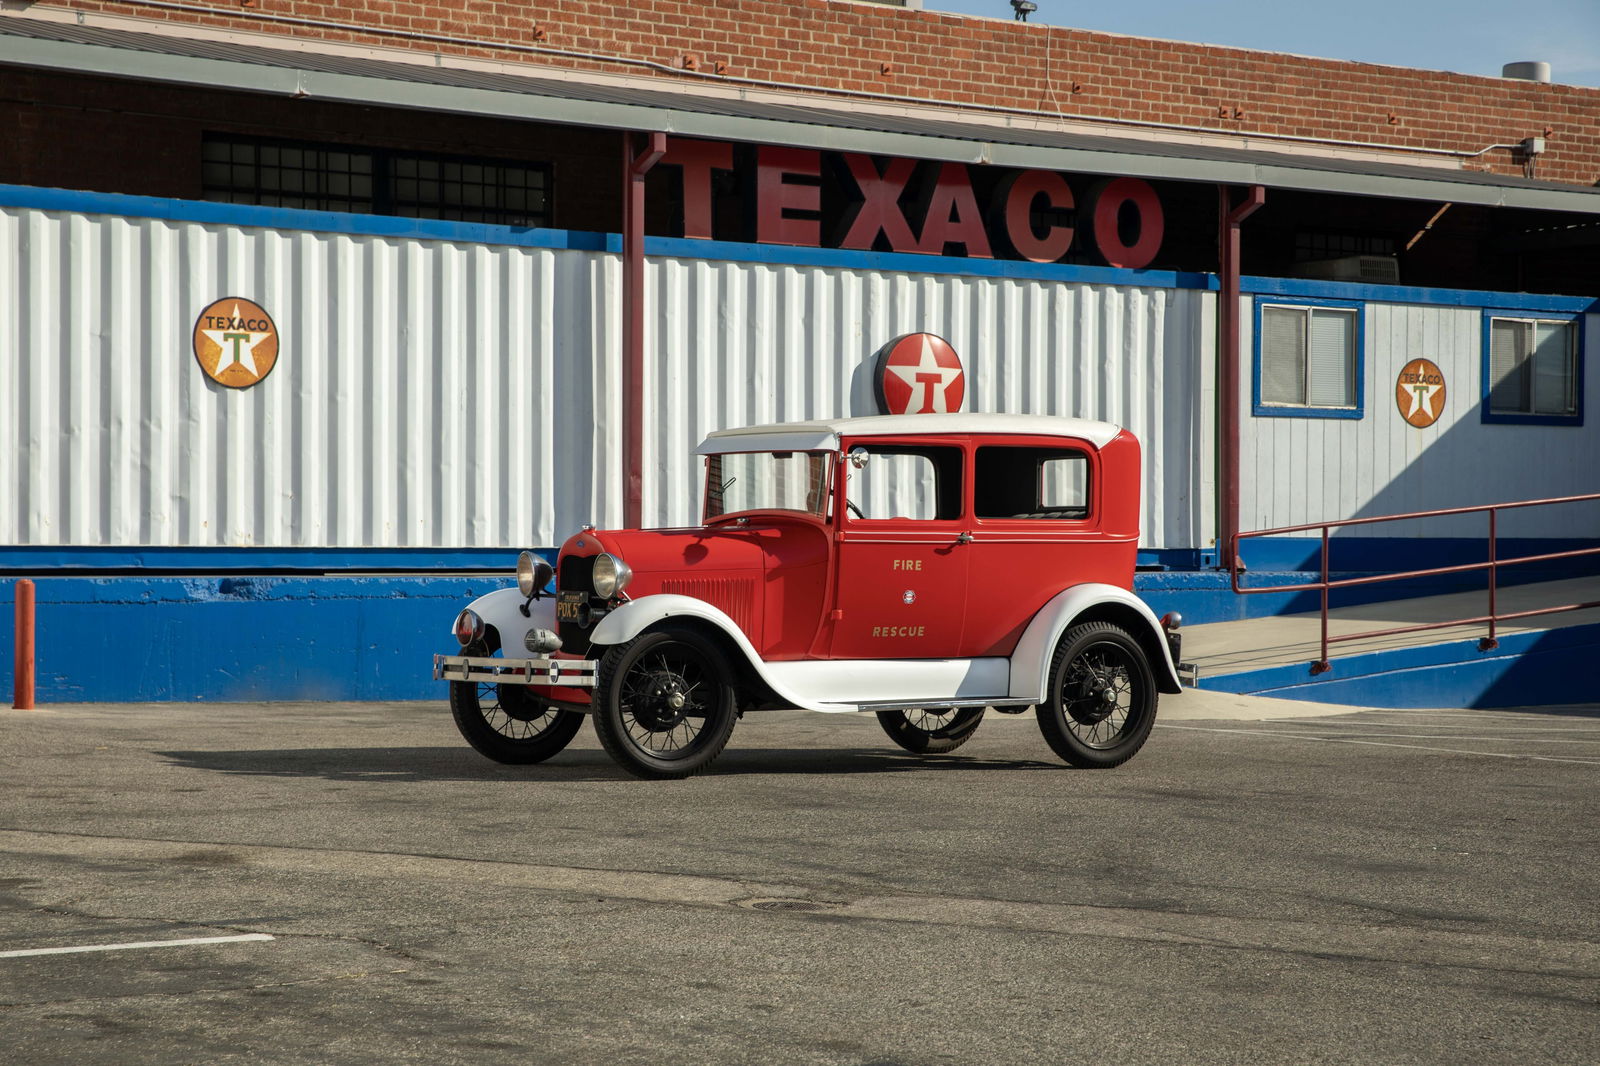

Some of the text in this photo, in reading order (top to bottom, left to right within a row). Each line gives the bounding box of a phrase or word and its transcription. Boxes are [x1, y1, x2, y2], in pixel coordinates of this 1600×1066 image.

[659, 138, 1165, 269] TEXACO
[205, 316, 269, 331] TEXACO
[223, 332, 250, 363] T
[1403, 373, 1441, 385] TEXACO
[1413, 385, 1429, 408] T
[893, 559, 922, 571] FIRE
[872, 626, 925, 637] RESCUE
